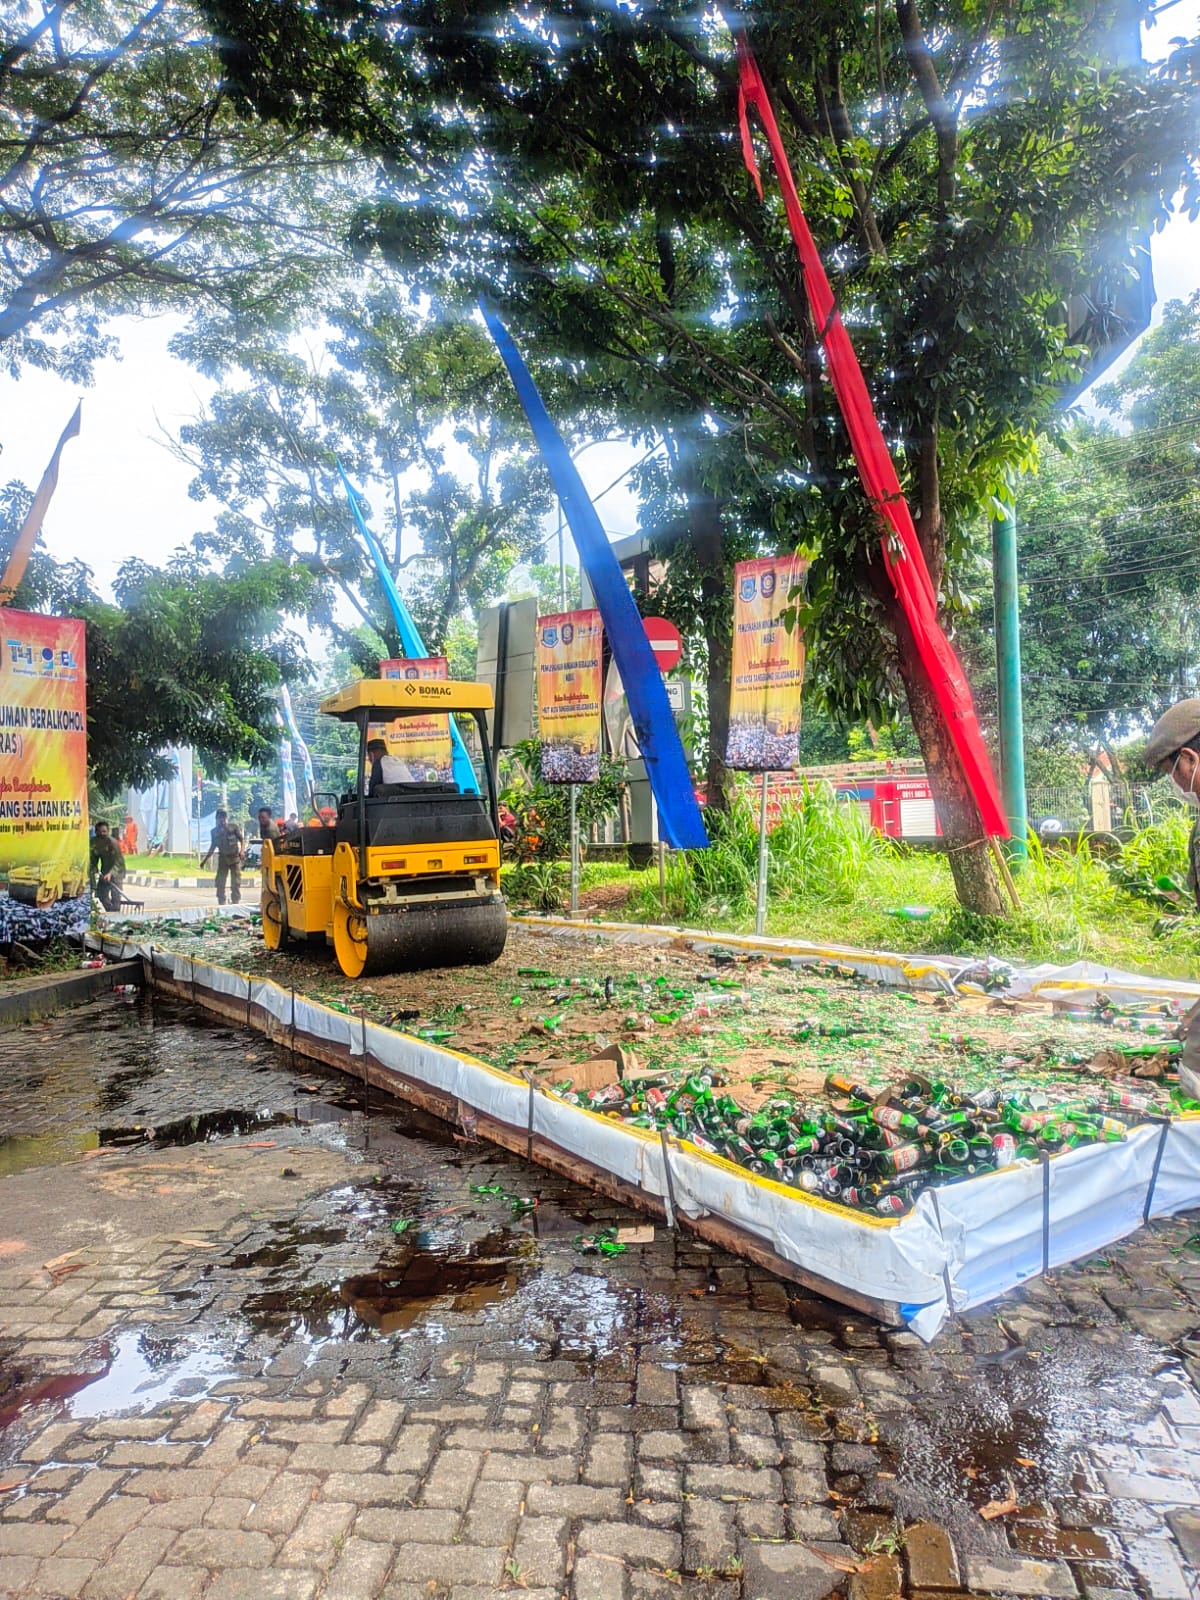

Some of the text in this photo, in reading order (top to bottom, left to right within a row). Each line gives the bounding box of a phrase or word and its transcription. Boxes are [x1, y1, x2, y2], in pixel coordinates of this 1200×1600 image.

[419, 686, 451, 696] BOMAG
[30, 707, 84, 731] BERALKOHOL
[897, 783, 926, 791] EMERGENCY
[22, 800, 58, 817] SELATAN
